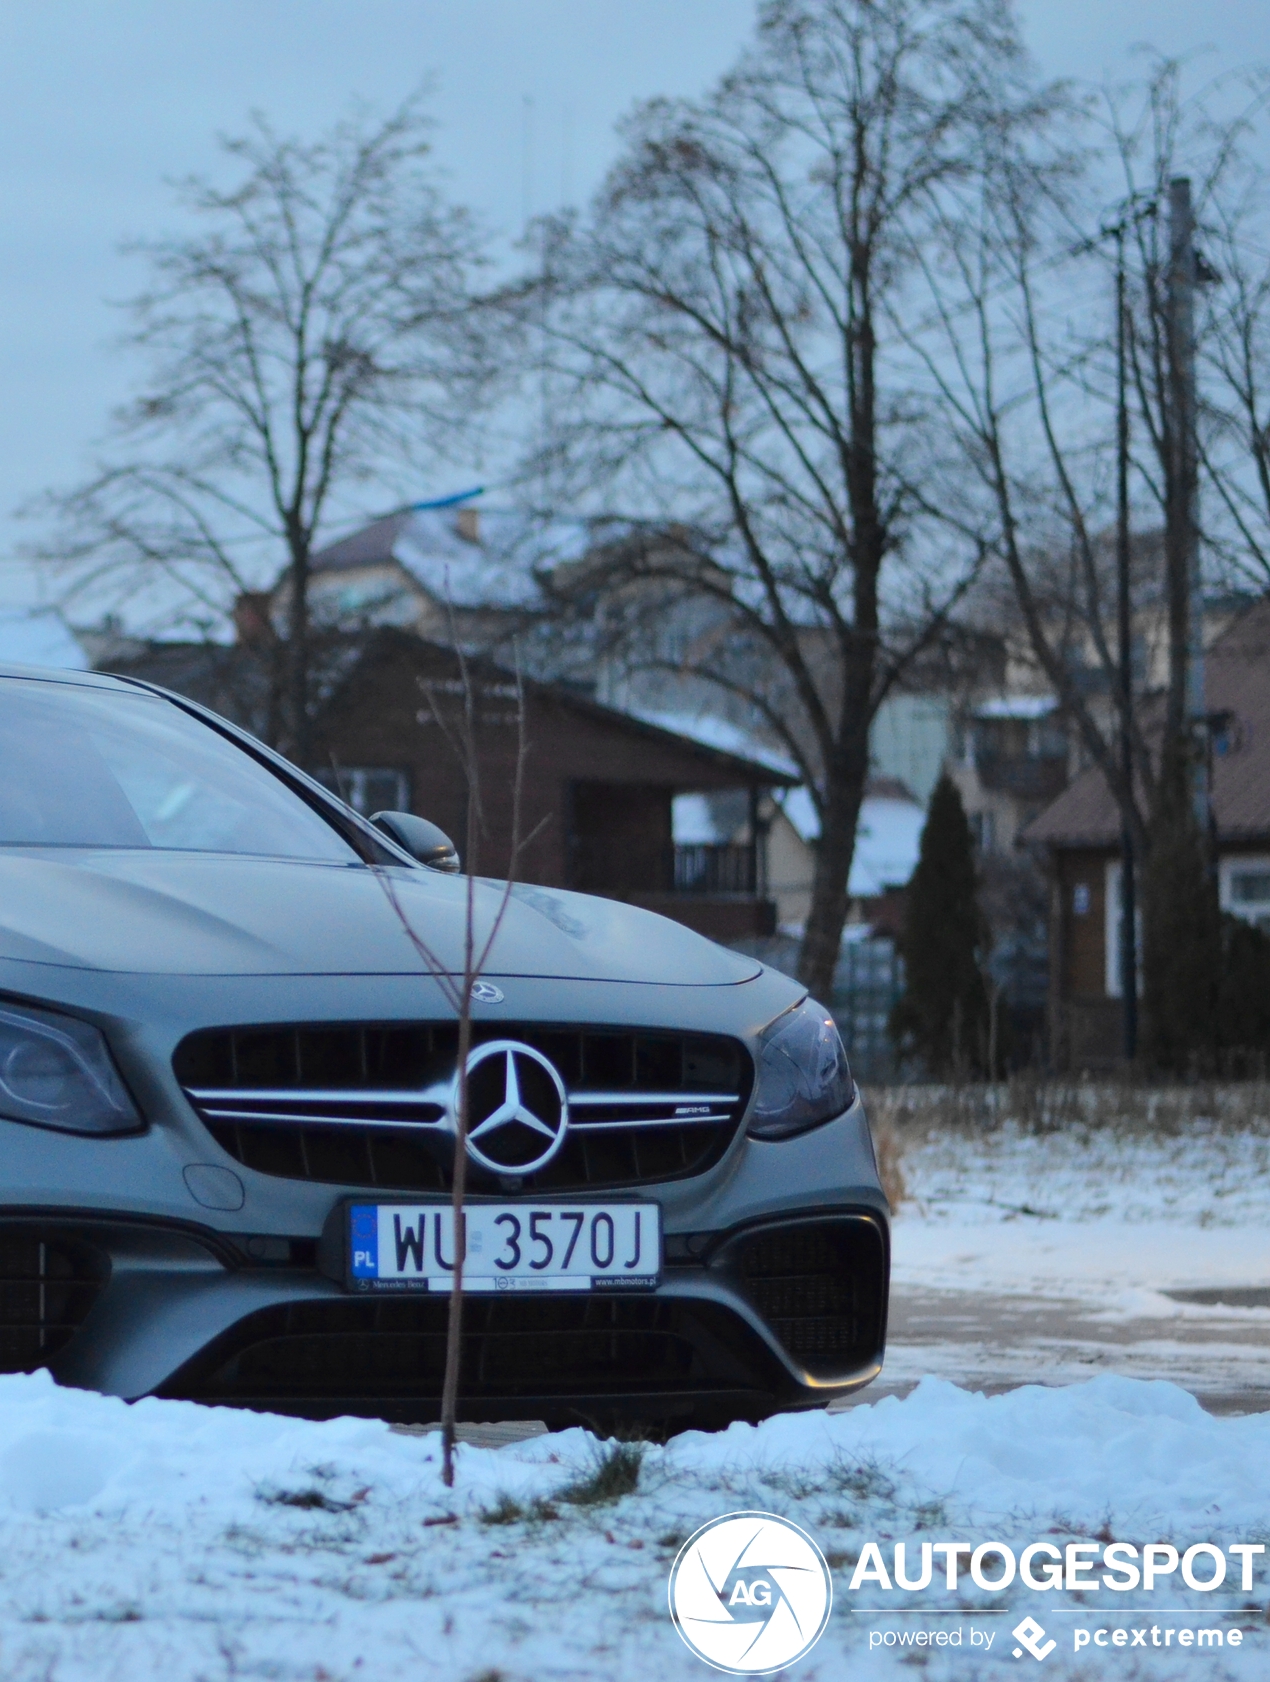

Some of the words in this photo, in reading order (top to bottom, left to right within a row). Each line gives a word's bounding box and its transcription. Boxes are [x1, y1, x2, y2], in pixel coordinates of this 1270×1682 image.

[393, 1213, 466, 1272] WU
[493, 1211, 641, 1270] 3570J
[354, 1251, 375, 1267] PL
[594, 1276, 656, 1287] www.mbmotors.pl
